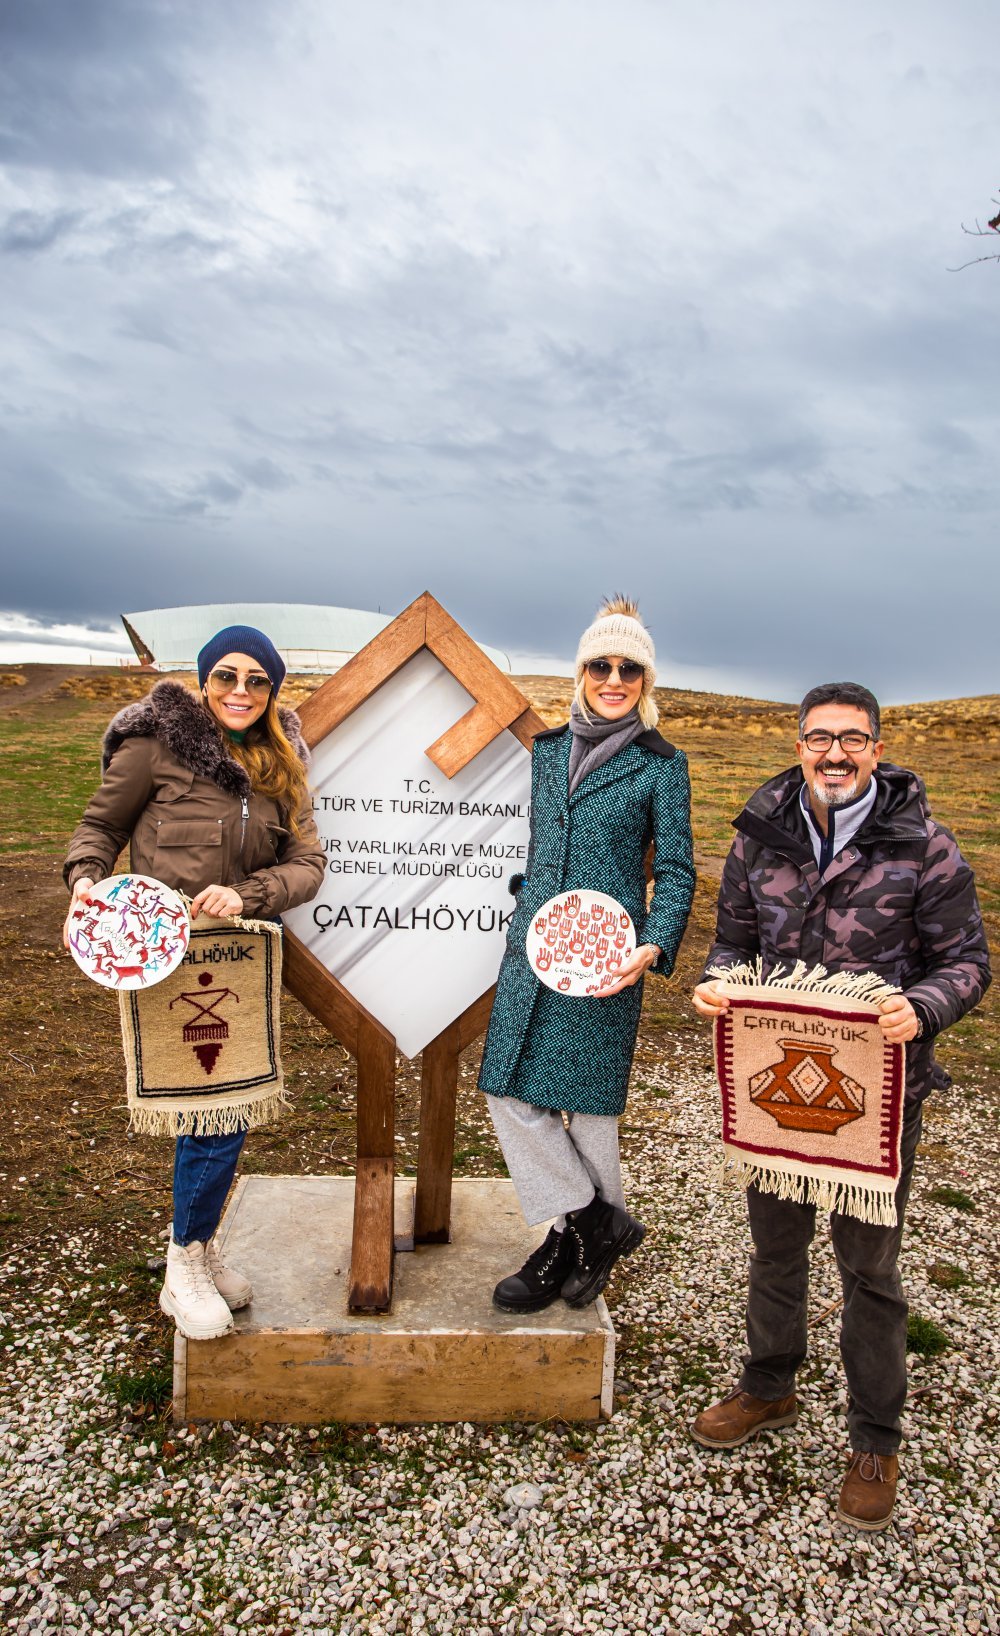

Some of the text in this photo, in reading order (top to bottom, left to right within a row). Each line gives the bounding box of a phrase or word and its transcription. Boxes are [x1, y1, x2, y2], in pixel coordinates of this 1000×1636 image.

[403, 779, 435, 794] T.C.
[311, 795, 530, 818] LTÜR VE TURİZM BAKANLI
[347, 840, 446, 857] VARLIKLARI
[451, 843, 474, 858] VE
[479, 842, 527, 859] MÜZE
[329, 859, 504, 879] GENEL MÜDÜRLÜĞÜ
[312, 904, 515, 933] ÇATALHÖYÜK
[181, 940, 256, 966] ALHÖYÜK
[743, 1014, 869, 1043] ÇATALHÖYÜK
